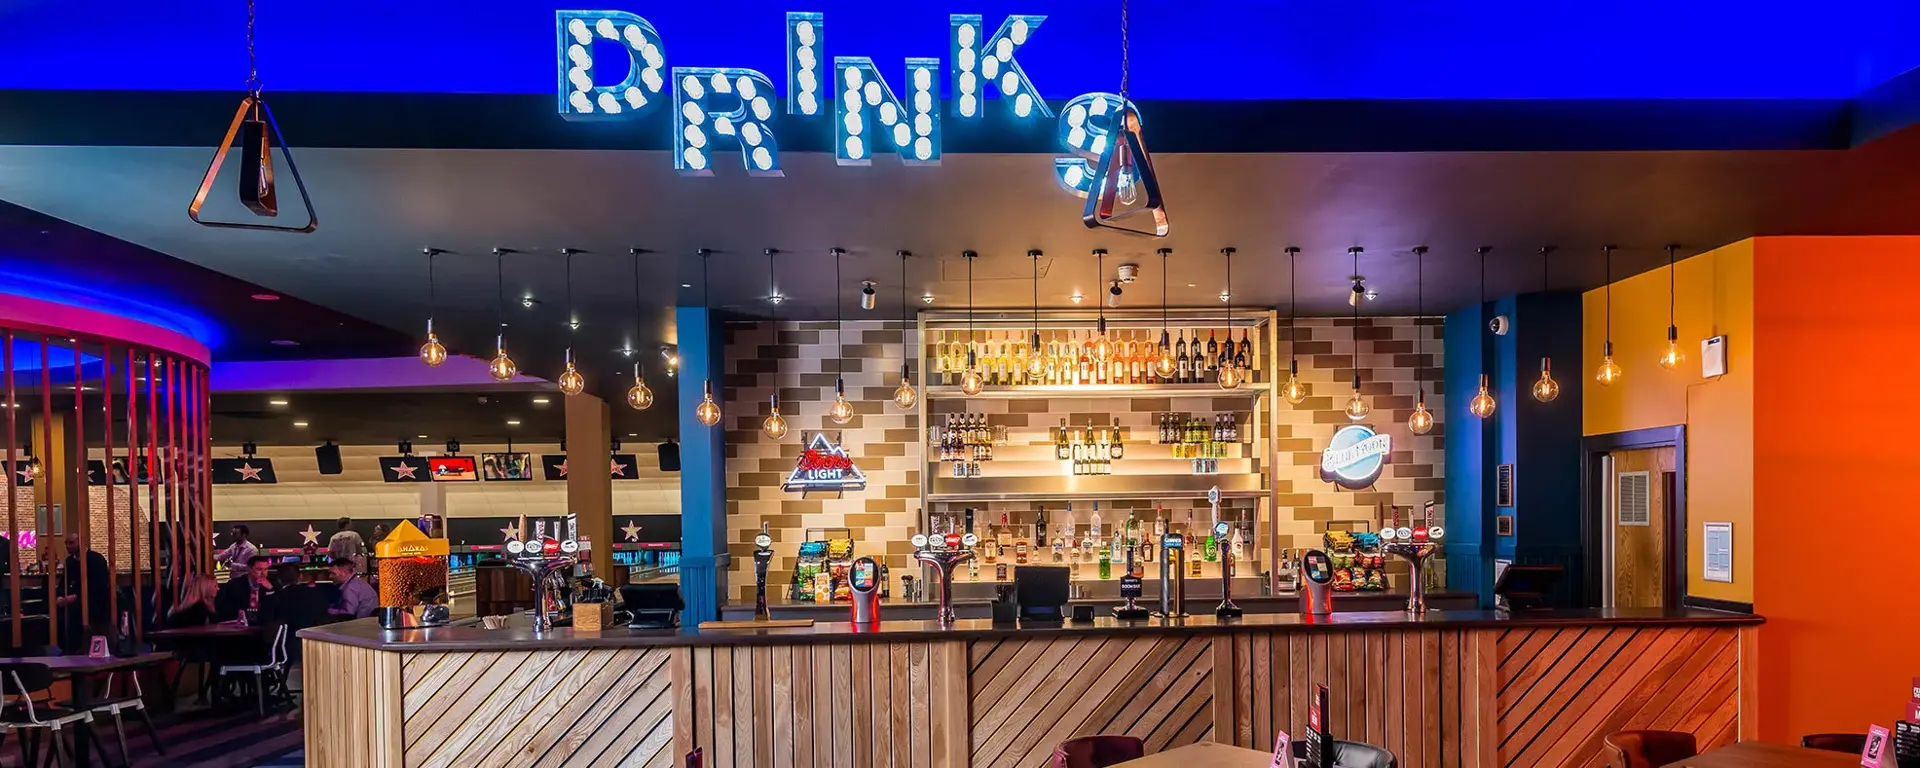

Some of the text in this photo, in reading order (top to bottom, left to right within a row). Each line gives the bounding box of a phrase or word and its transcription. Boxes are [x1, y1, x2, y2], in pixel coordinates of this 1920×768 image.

[556, 10, 1143, 199] DRINKS
[799, 448, 852, 471] Coors
[808, 469, 843, 480] LIGHT
